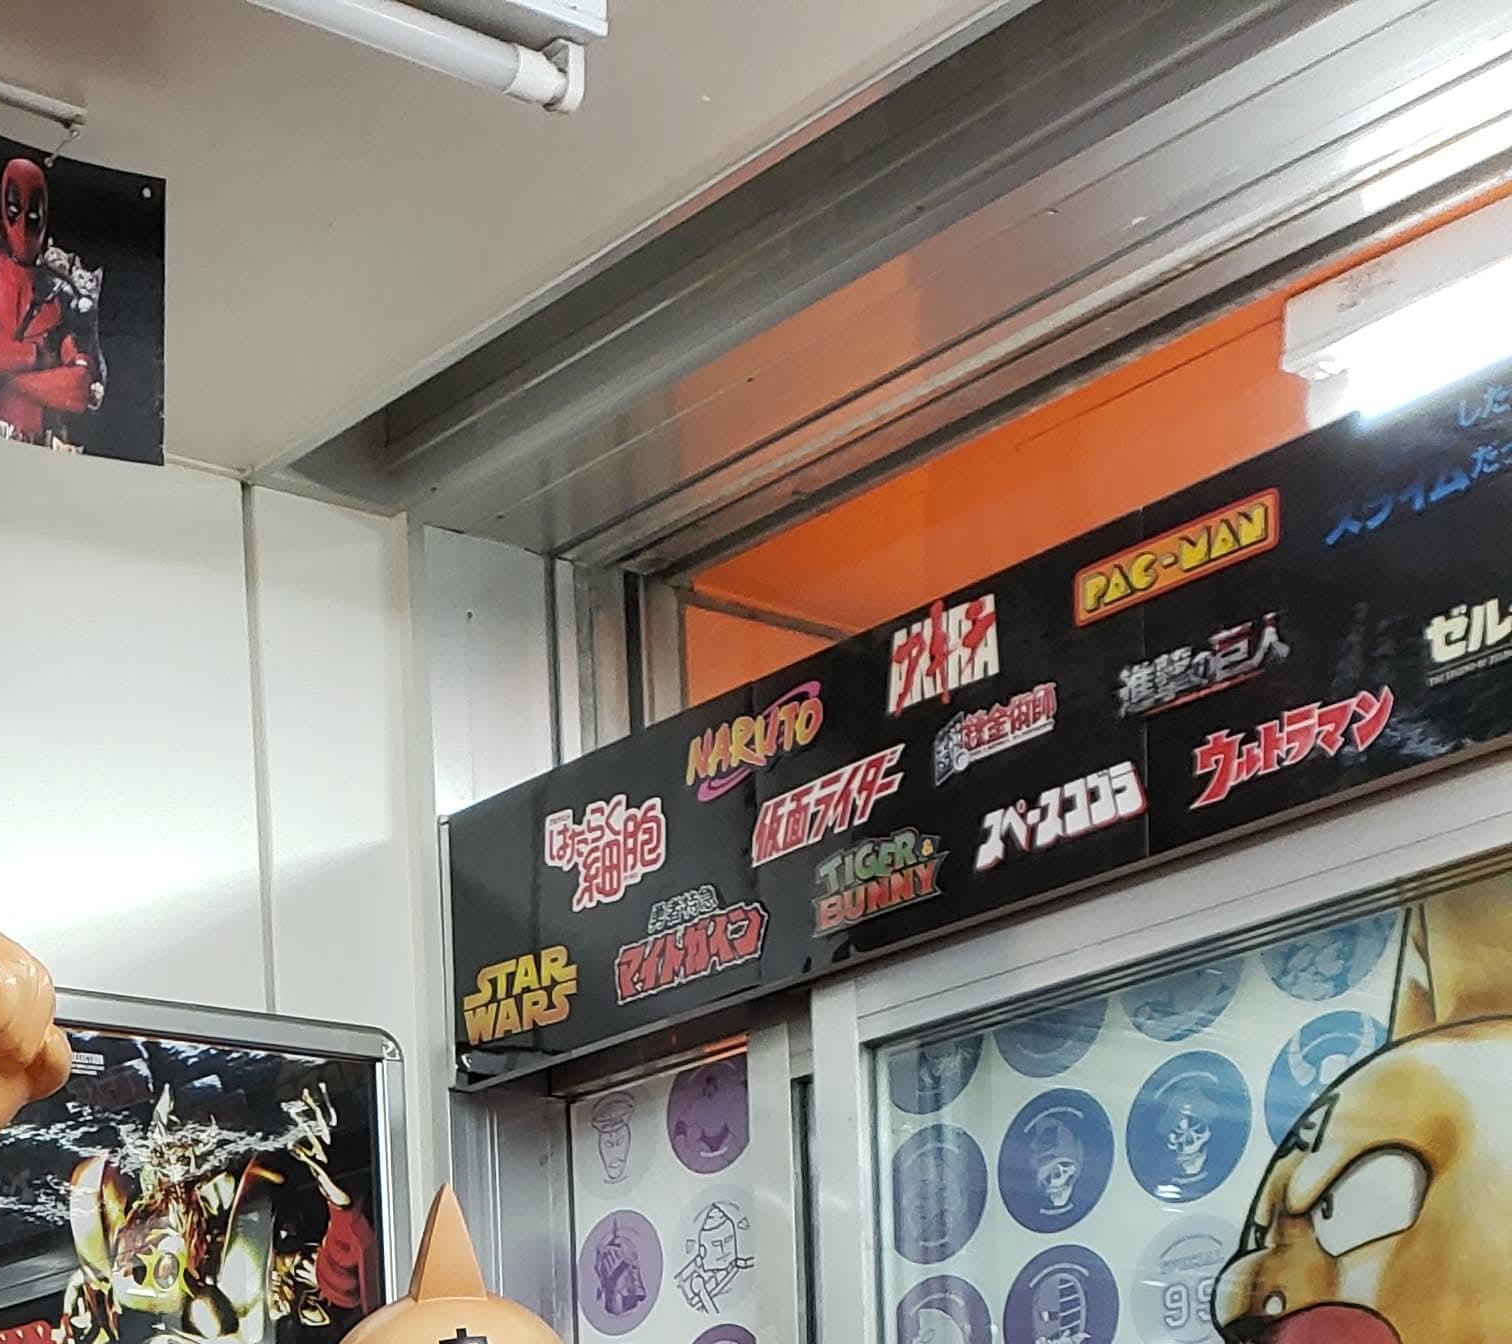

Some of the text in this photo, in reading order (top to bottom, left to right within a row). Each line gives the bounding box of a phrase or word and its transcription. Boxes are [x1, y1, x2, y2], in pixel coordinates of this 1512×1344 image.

[1080, 500, 1270, 614] PAC-MAN
[1117, 612, 1291, 718] 進撃の巨人
[685, 695, 824, 787] NARUTO
[1190, 684, 1395, 809] ウルトラマン
[752, 745, 906, 868] 仮面ライダー
[818, 830, 919, 895] TIGER
[818, 860, 938, 931] BUNNY
[464, 945, 578, 1009] STAR
[464, 980, 577, 1046] WARS
